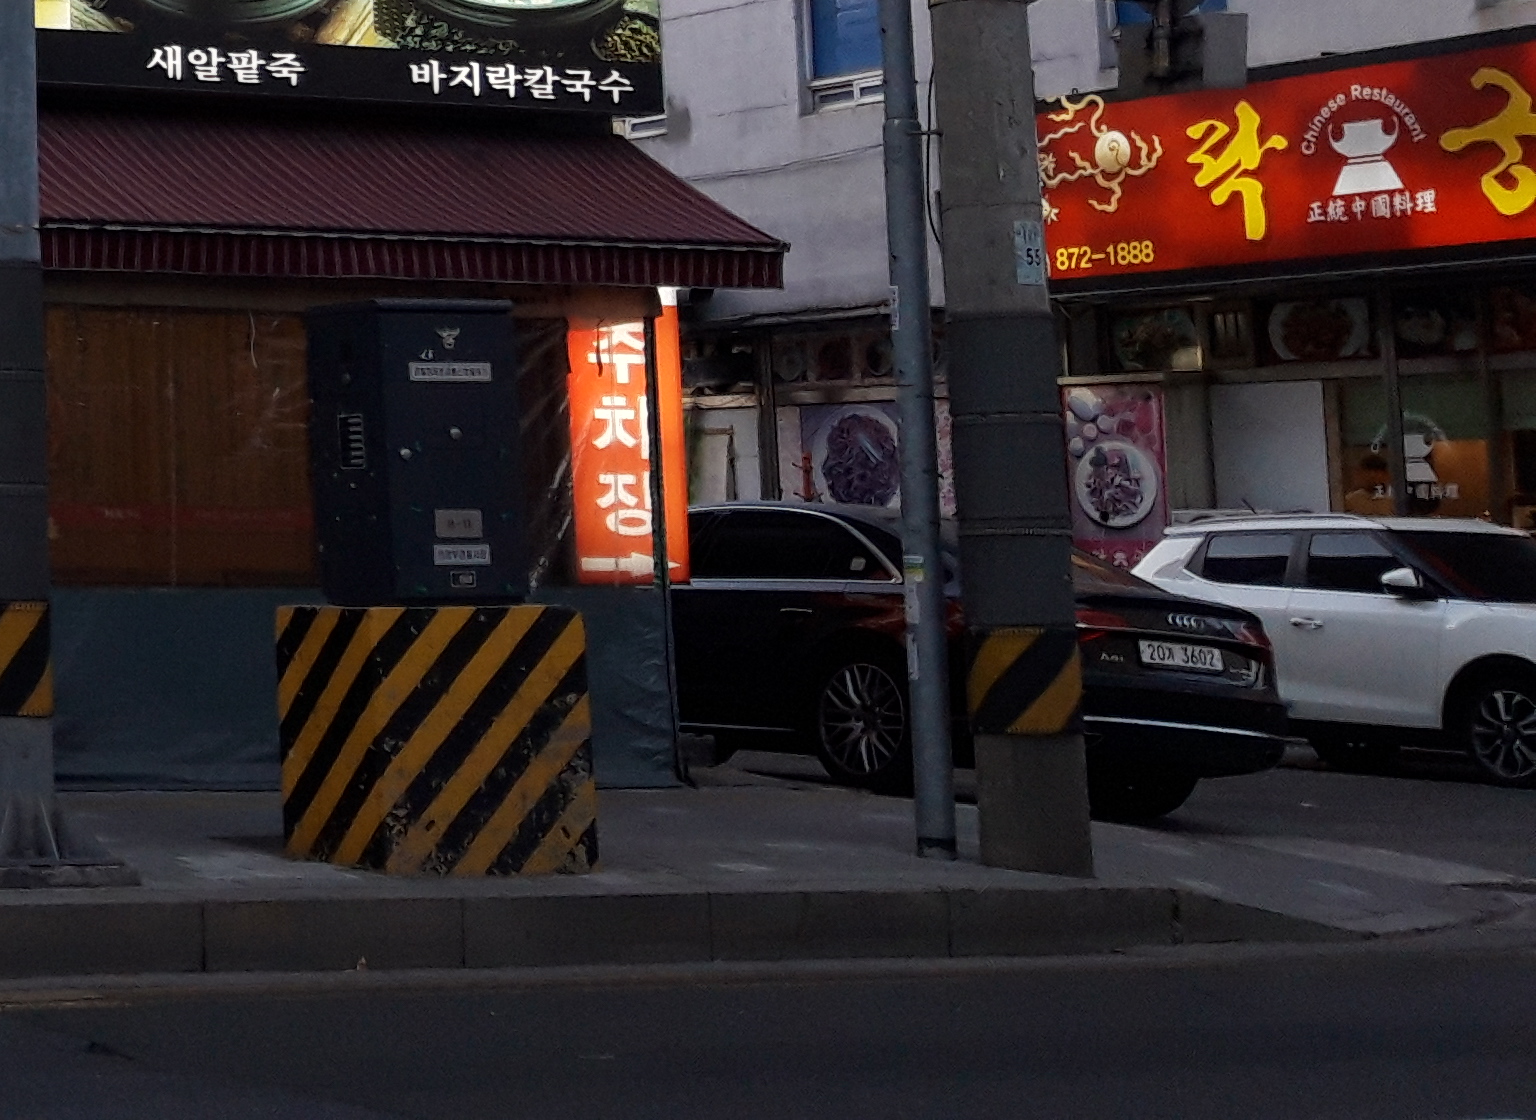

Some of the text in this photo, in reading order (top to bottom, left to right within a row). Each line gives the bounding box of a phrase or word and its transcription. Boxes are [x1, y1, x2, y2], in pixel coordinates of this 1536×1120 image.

[146, 44, 306, 87] 새알팥죽
[410, 59, 636, 105] 바지락칼국수
[1301, 83, 1428, 156] Chinese Restaurant
[1185, 99, 1289, 241] 락
[1055, 239, 1155, 271] 872-1888
